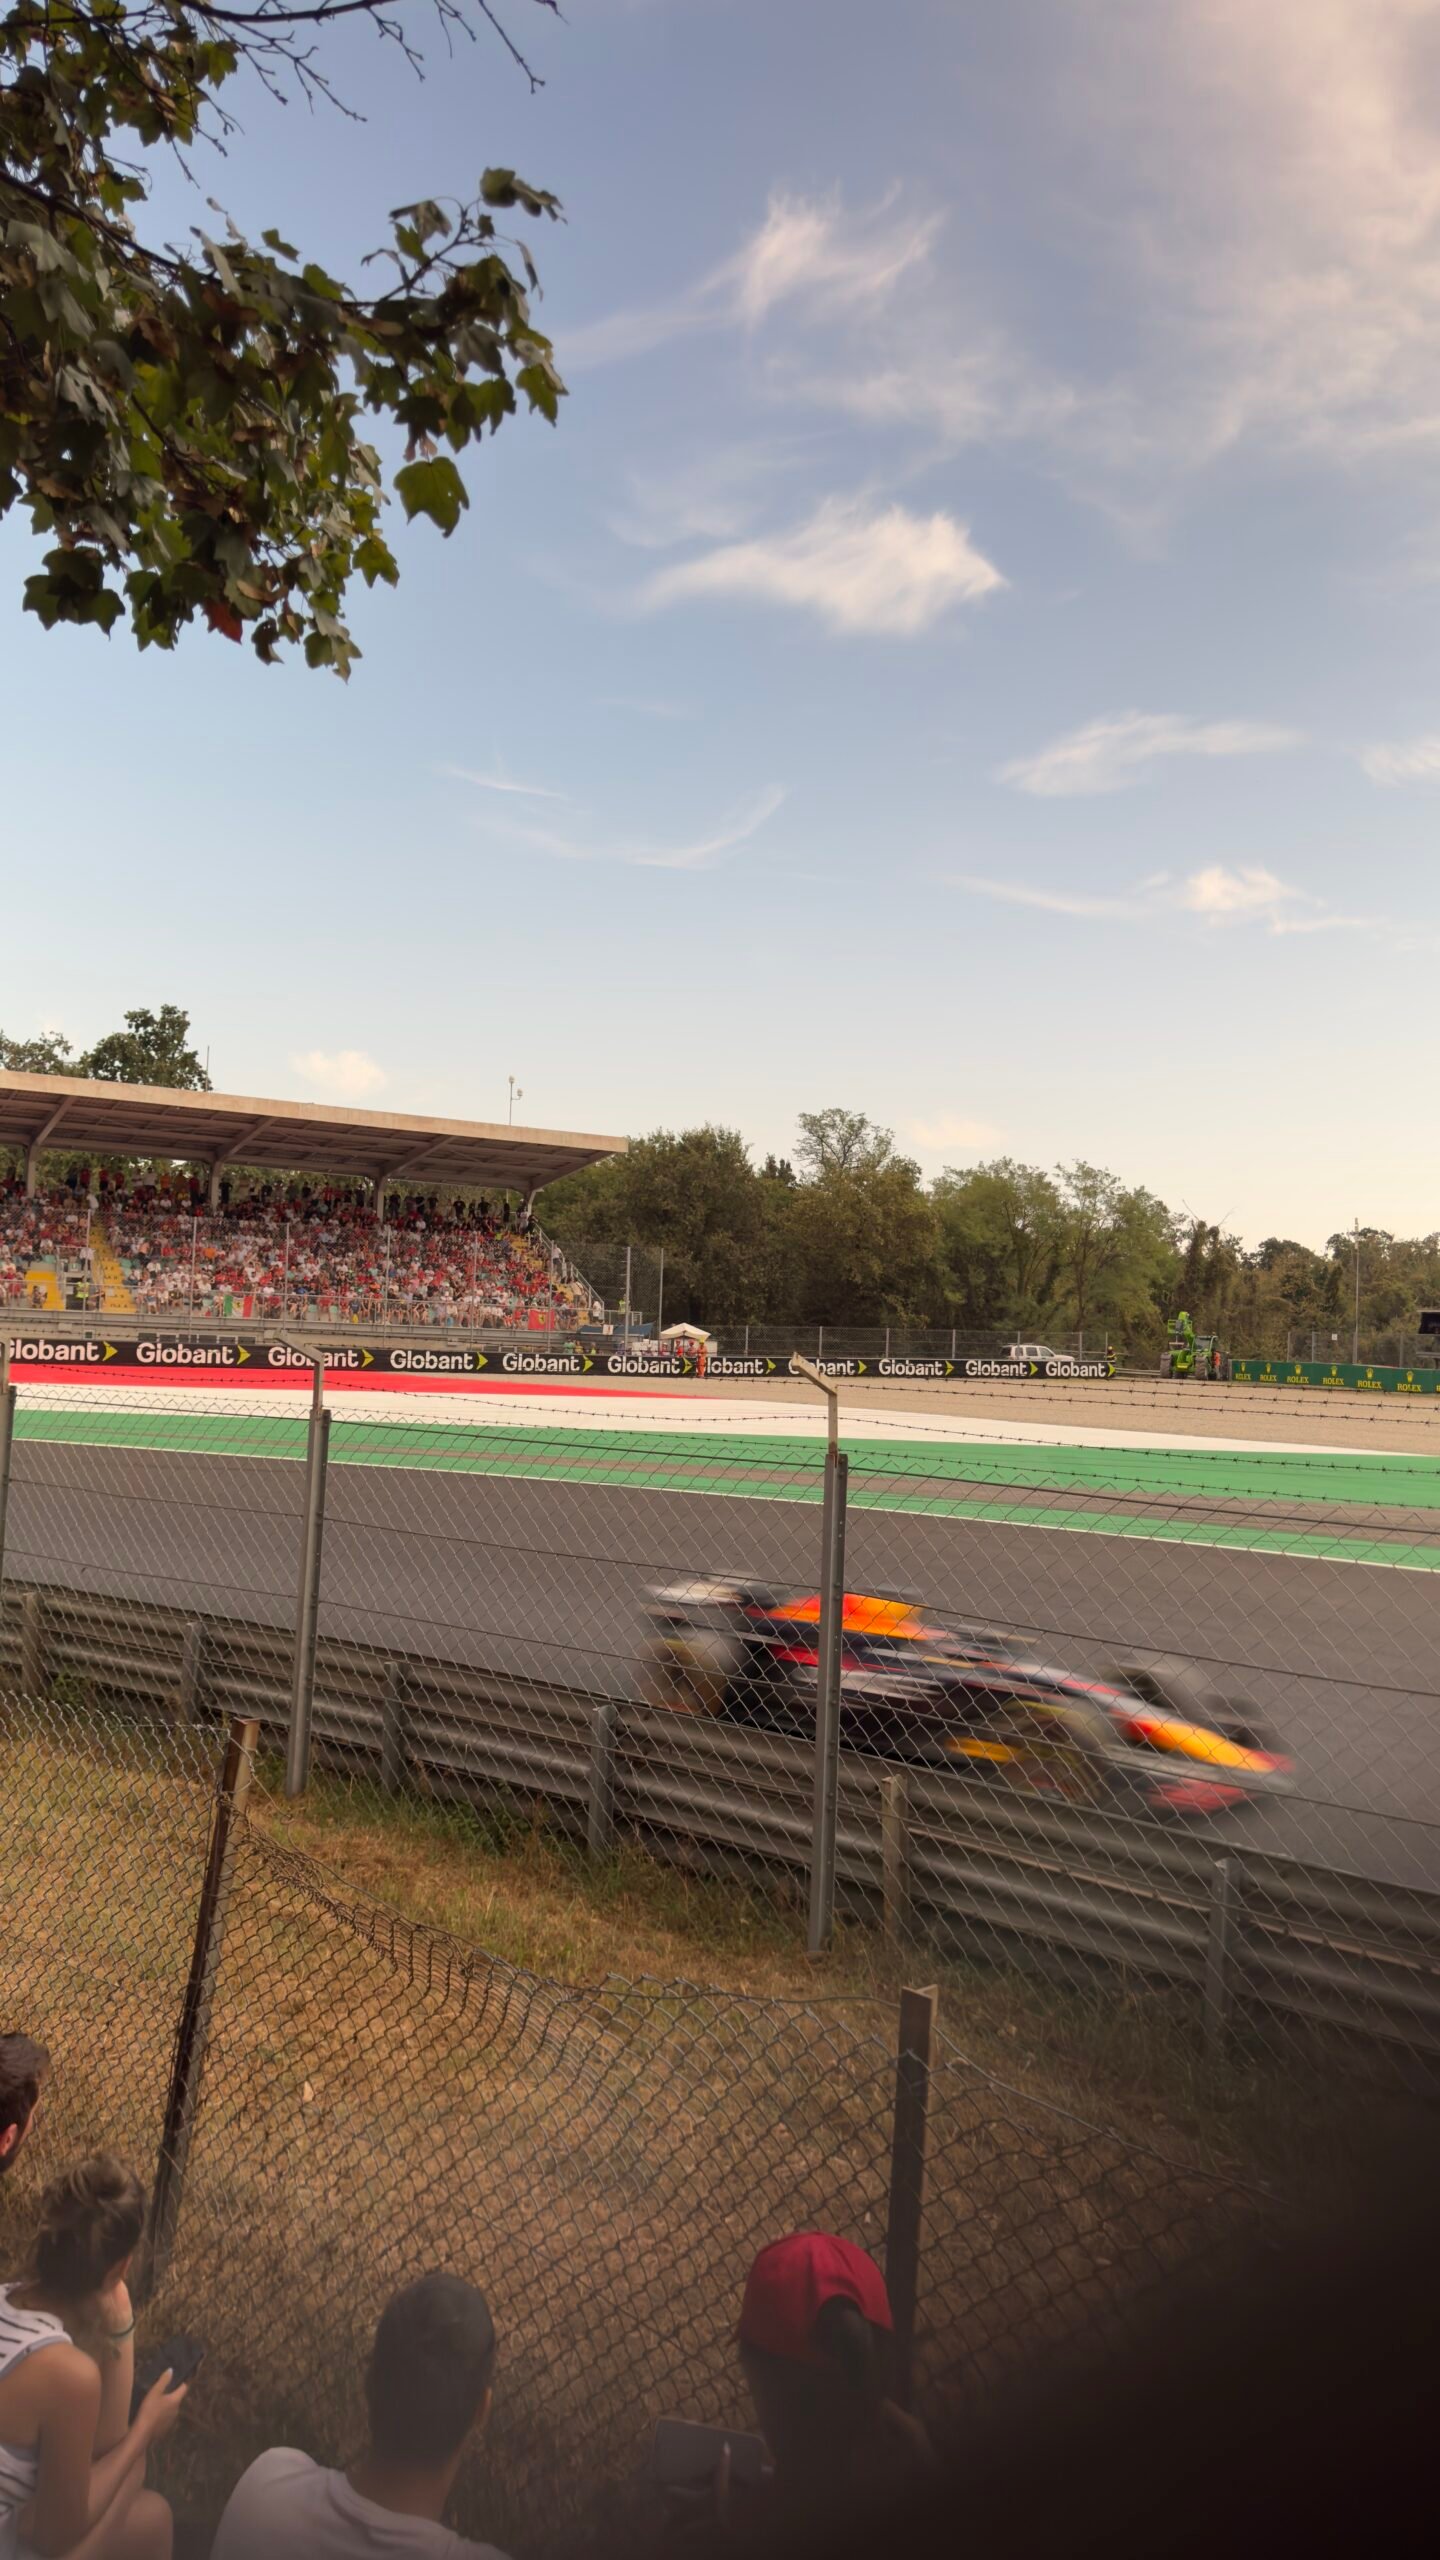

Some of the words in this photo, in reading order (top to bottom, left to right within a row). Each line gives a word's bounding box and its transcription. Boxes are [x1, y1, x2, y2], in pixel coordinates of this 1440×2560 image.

[136, 1342, 234, 1365] Globant
[390, 1350, 473, 1370] Globant
[503, 1352, 580, 1372] Globant
[608, 1355, 680, 1374] Globant
[704, 1357, 763, 1374] lobant
[879, 1359, 943, 1376] Globant
[966, 1360, 1027, 1377] Globant
[1046, 1361, 1106, 1377] Globant
[1286, 1376, 1309, 1384] ROLEX
[1357, 1380, 1382, 1389] ROLEX
[1397, 1383, 1421, 1392] ROLEX
